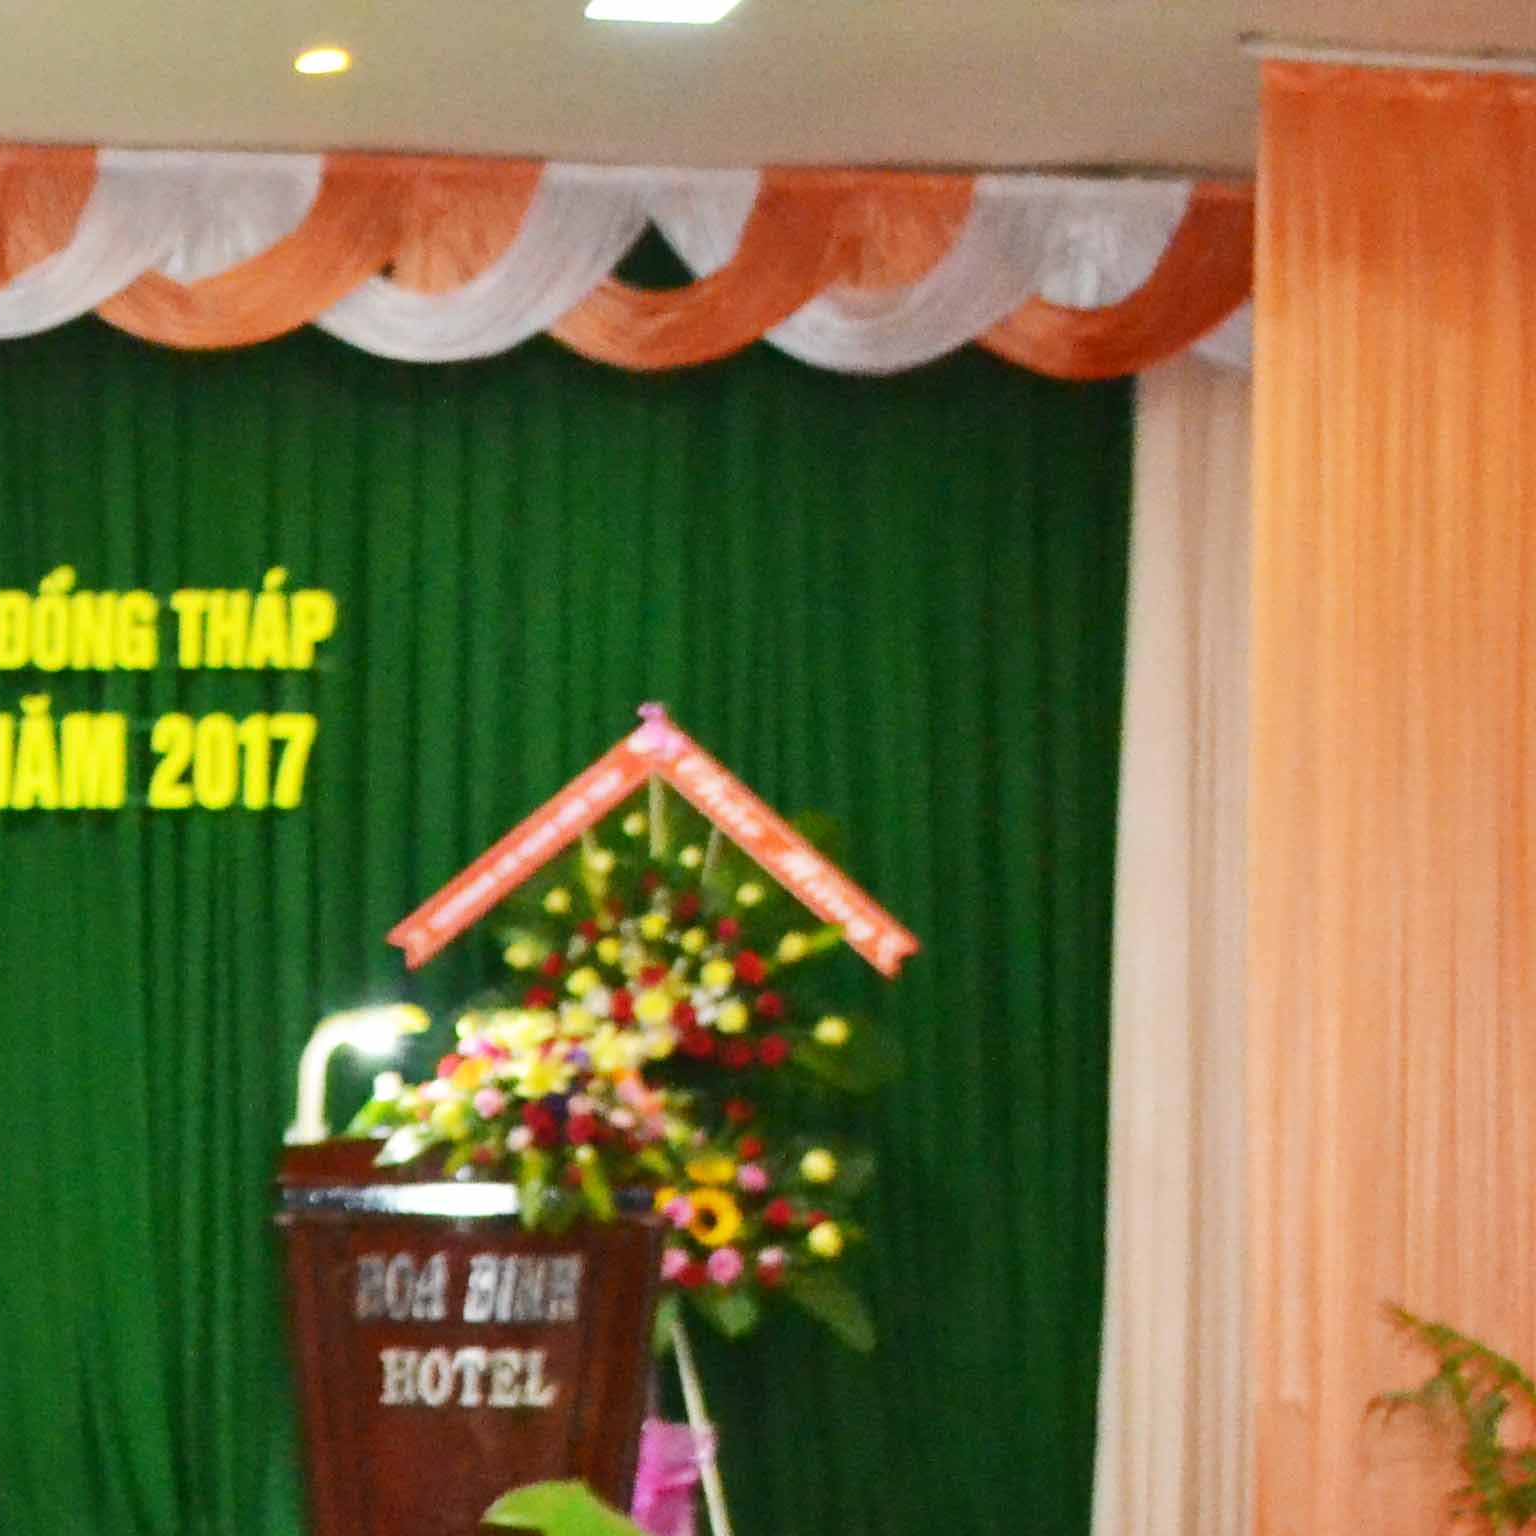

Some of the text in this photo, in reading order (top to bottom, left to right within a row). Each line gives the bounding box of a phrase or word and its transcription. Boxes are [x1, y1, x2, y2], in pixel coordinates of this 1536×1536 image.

[169, 566, 338, 670] THÁP
[148, 711, 318, 811] 2017
[379, 1345, 560, 1408] HOTEL
